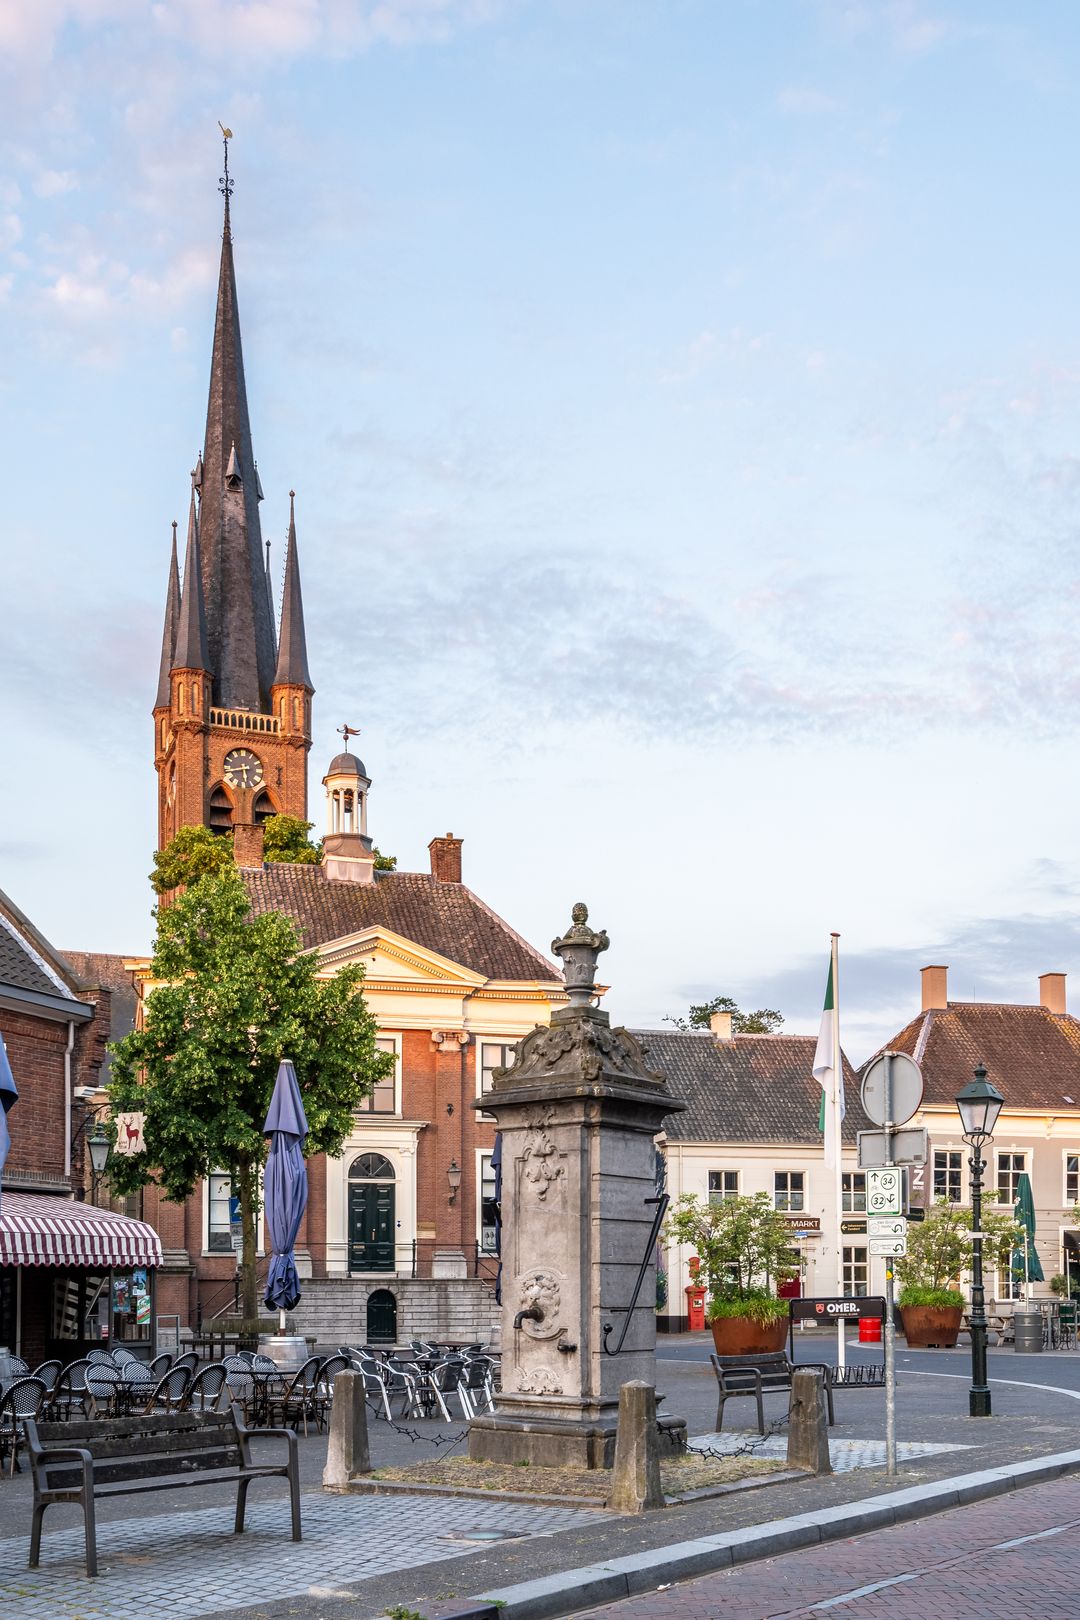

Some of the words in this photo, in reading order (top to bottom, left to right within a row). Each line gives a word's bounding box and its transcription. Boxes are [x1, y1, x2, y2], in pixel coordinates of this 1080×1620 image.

[883, 1177, 893, 1185] 34
[874, 1197, 884, 1205] 32
[791, 1220, 818, 1228] MARKT
